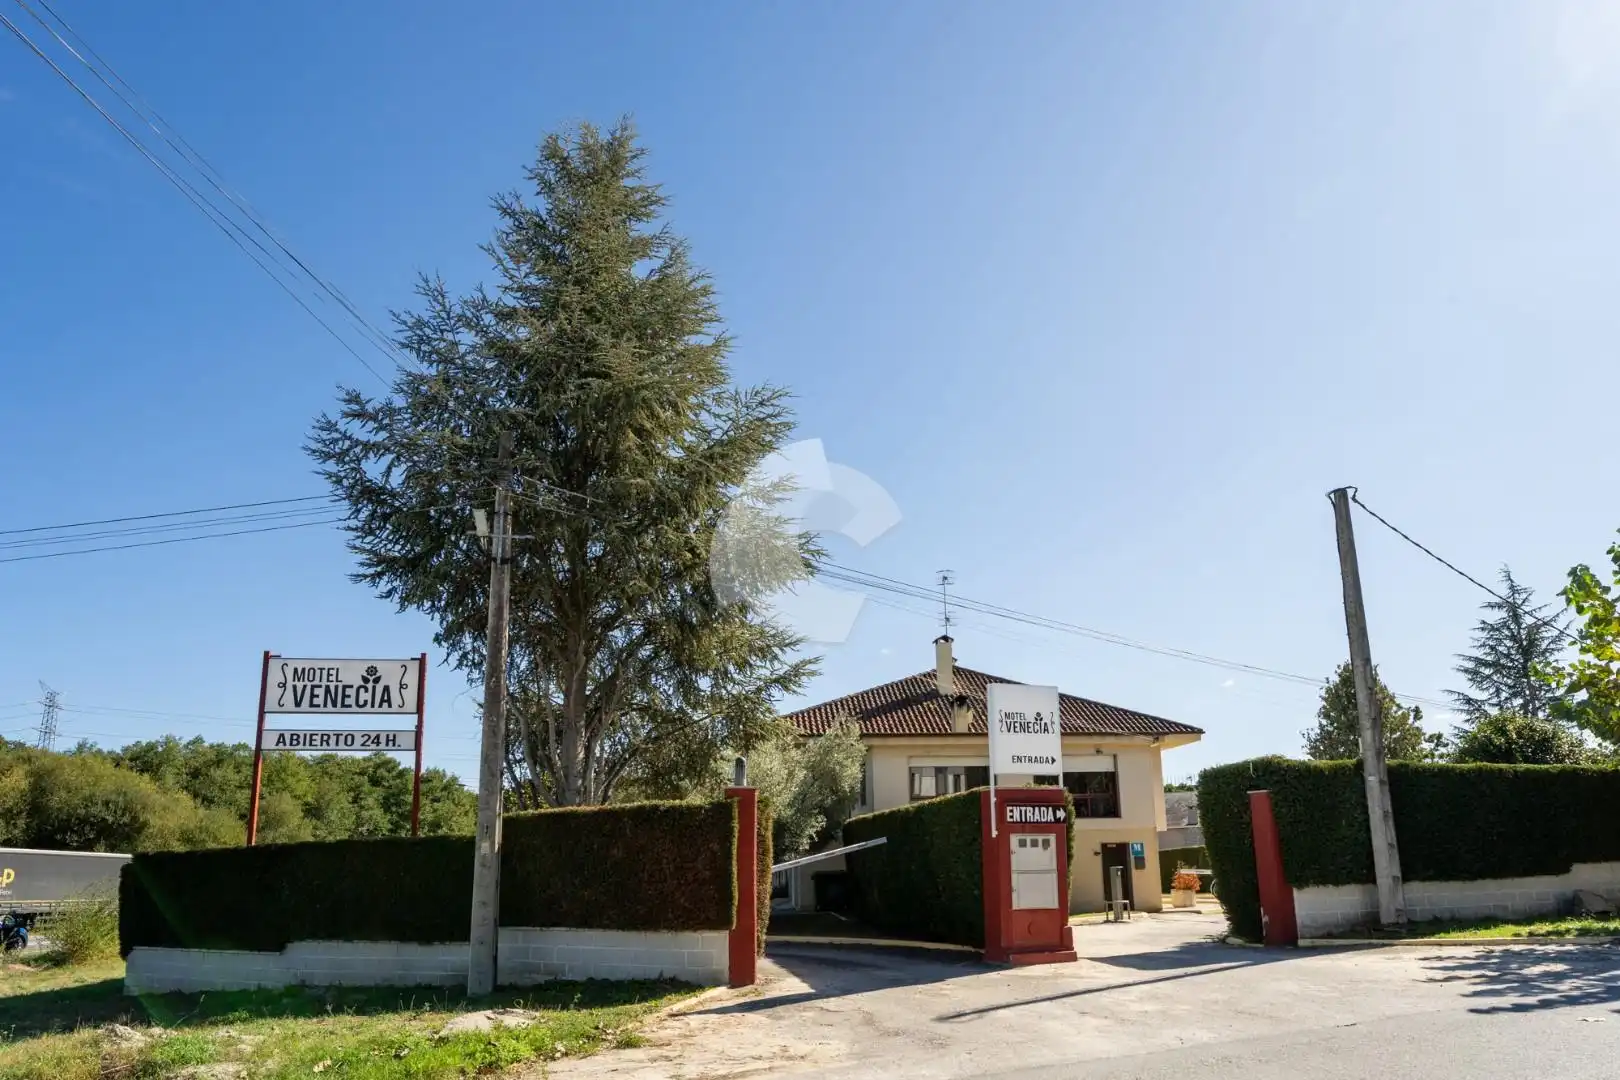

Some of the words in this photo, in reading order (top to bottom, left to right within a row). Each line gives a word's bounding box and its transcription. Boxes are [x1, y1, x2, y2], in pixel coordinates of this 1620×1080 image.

[292, 667, 343, 683] MOTEL
[292, 684, 393, 709] VENECIA
[1004, 711, 1026, 721] MOTEL
[1005, 720, 1050, 735] VENECIA
[275, 732, 355, 747] ABIERTO
[1011, 755, 1050, 765] ENTRADA
[1006, 805, 1055, 823] ENTRADA
